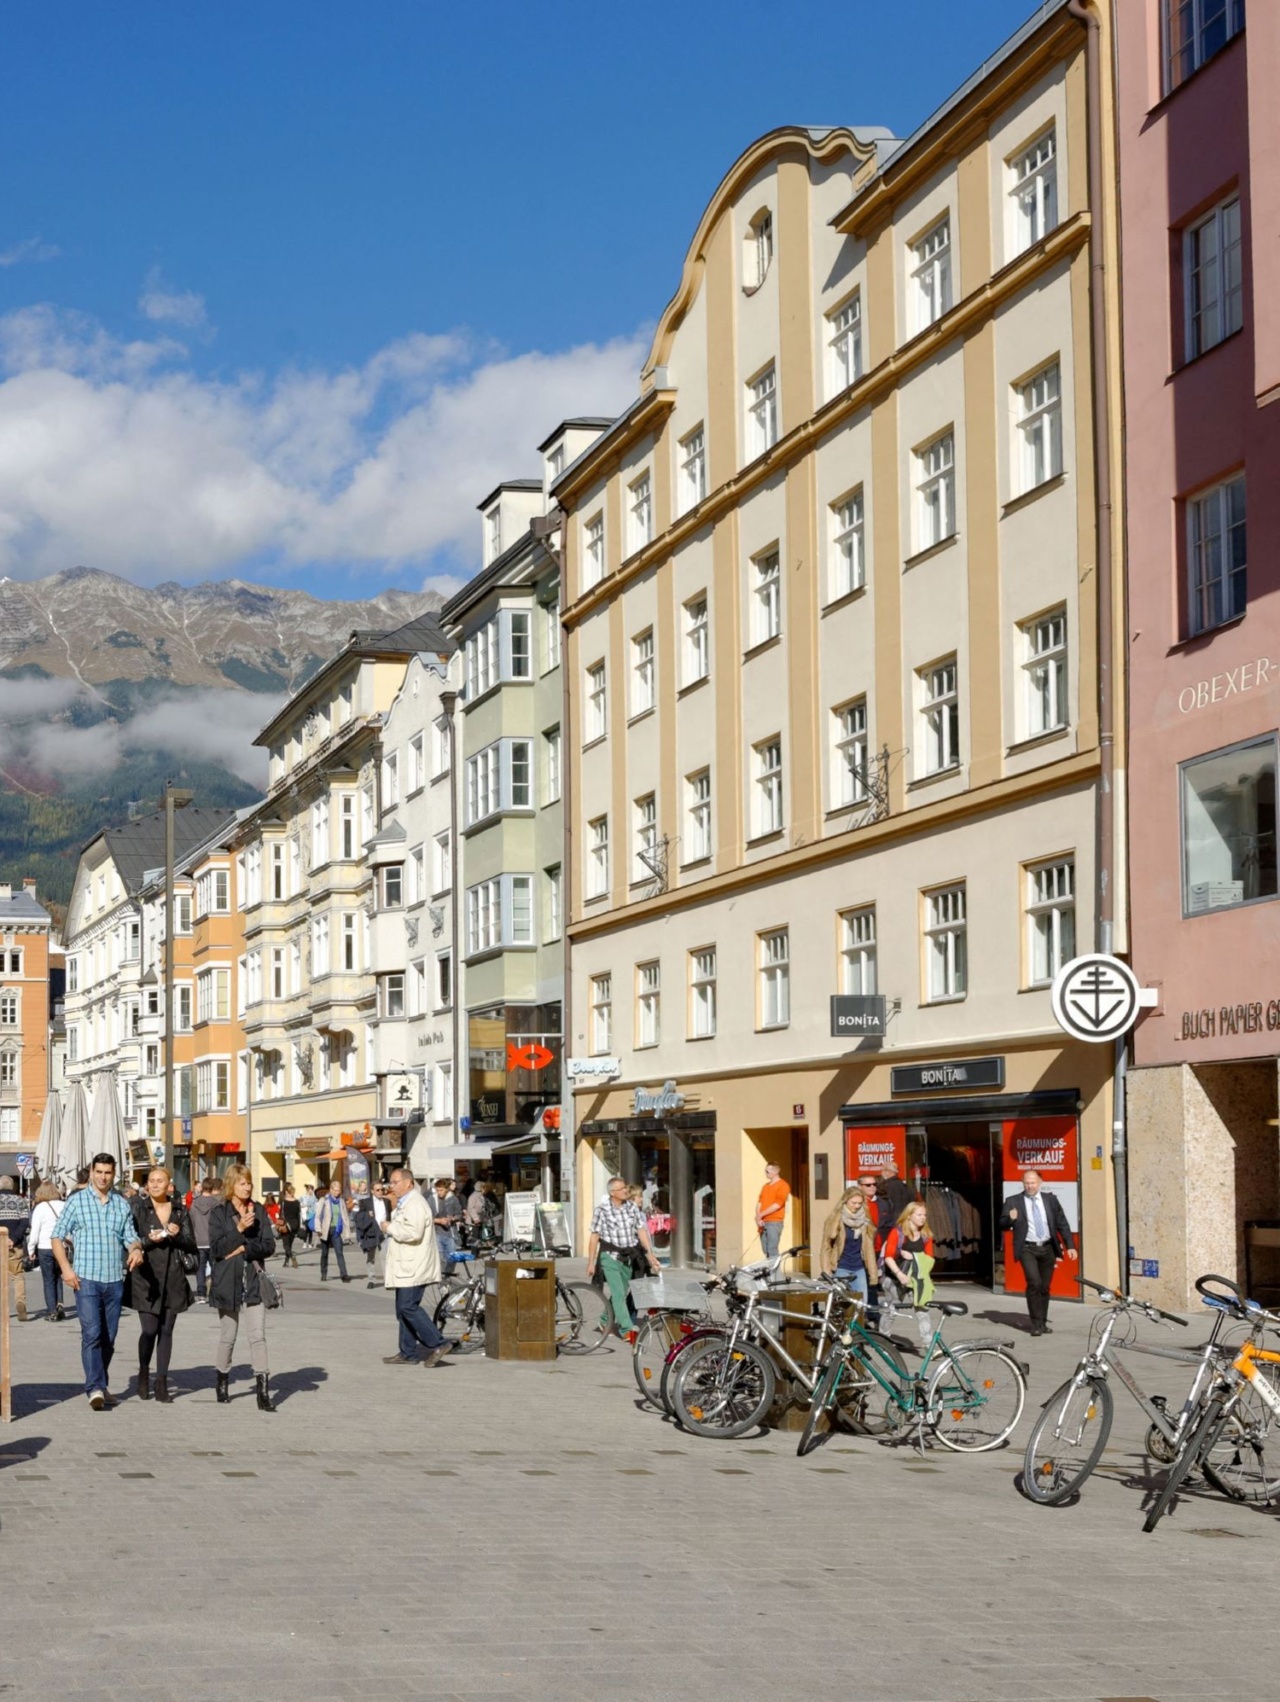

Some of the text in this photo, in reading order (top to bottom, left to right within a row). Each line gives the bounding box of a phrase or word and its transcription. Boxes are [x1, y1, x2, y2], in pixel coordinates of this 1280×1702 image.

[838, 1013, 880, 1027] BONITA
[1181, 1006, 1215, 1041] BUCH
[1219, 1002, 1263, 1036] PAPIER
[921, 1065, 959, 1086] BONITA
[1017, 1137, 1067, 1149] RÄUMUNGS-
[1017, 1150, 1065, 1164] VERKAUF
